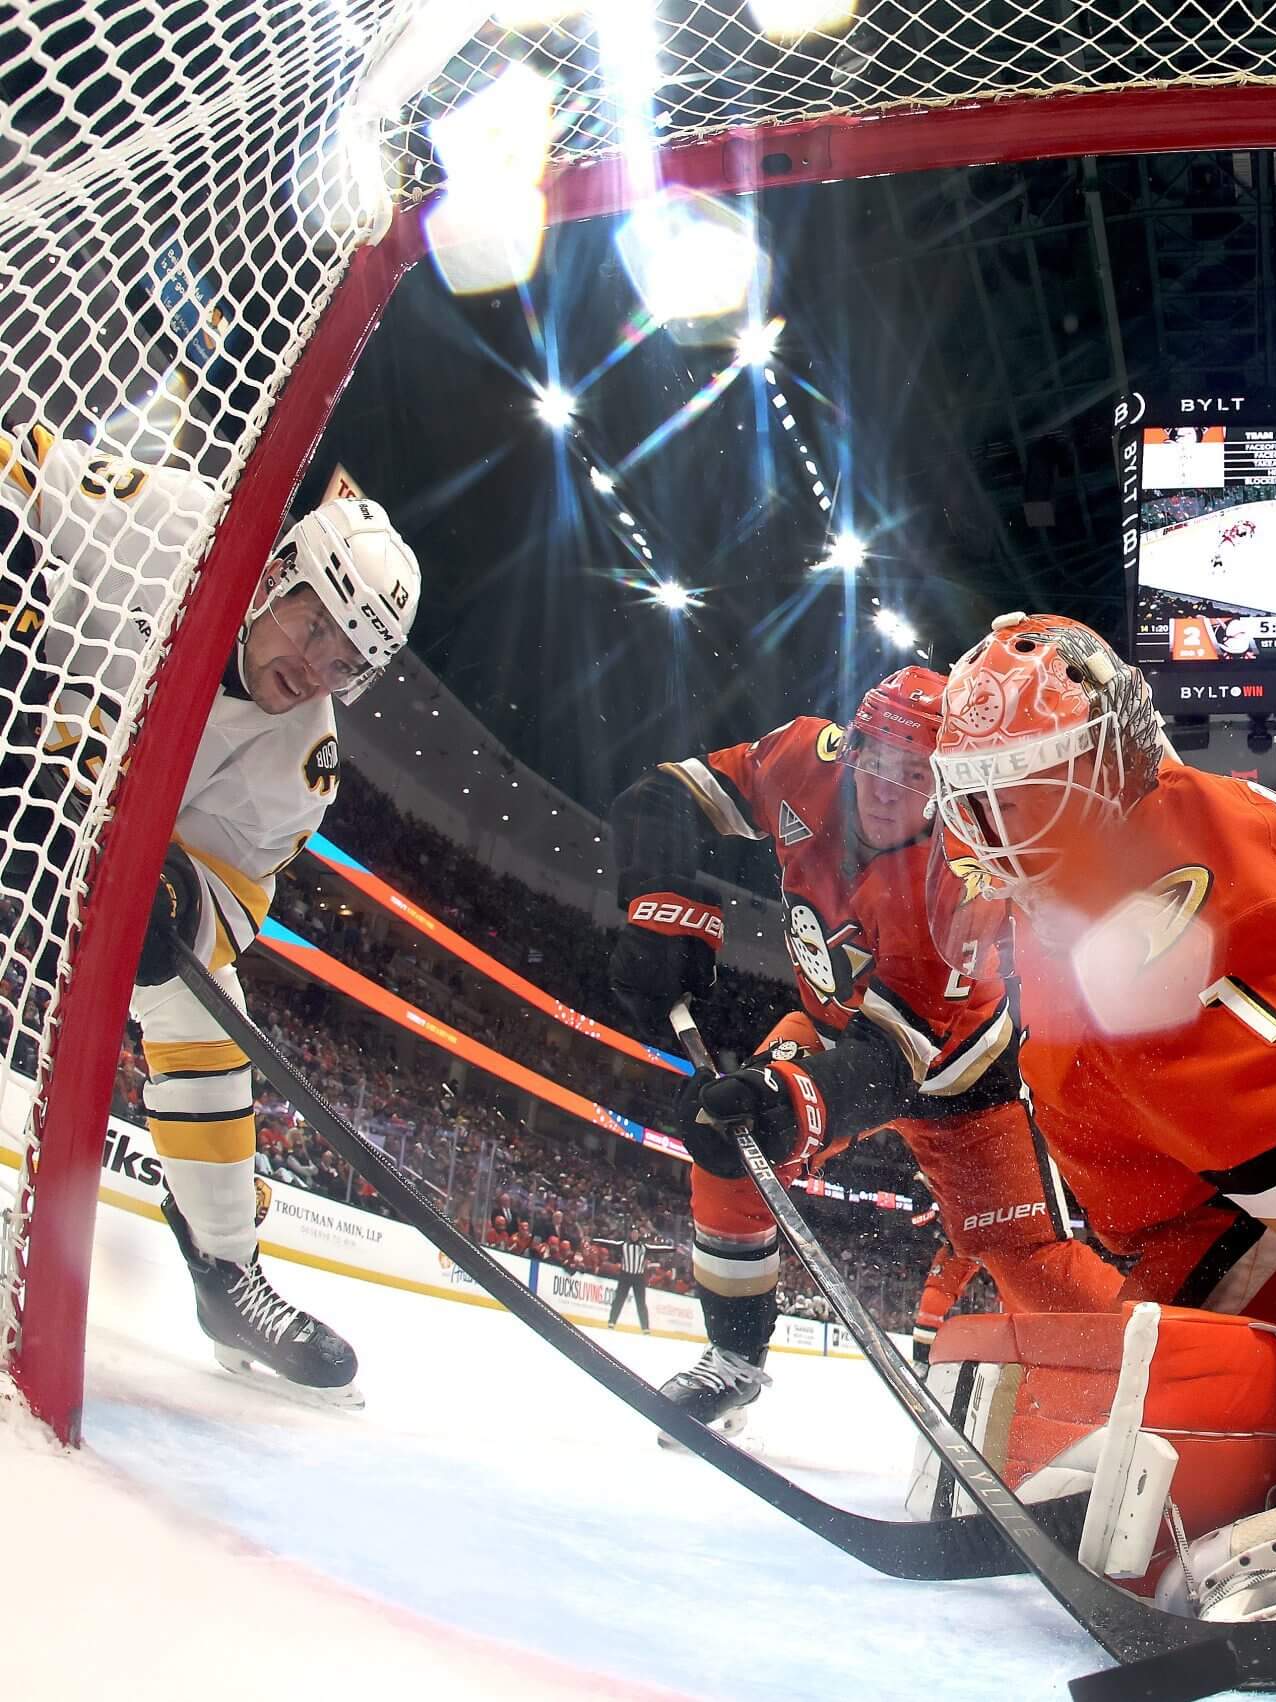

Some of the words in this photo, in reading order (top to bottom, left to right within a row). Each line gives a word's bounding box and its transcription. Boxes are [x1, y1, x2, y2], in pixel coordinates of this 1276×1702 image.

[1181, 398, 1245, 415] BYLT
[1123, 441, 1138, 503] BYLT
[390, 579, 410, 609] 13
[361, 602, 394, 642] CCM
[1183, 626, 1201, 647] 2
[909, 688, 924, 702] 2
[883, 711, 921, 729] BAUER
[274, 1199, 334, 1229] TROUTMAN
[336, 1220, 365, 1239] AMIN,
[366, 1228, 383, 1243] LLP
[963, 1202, 1046, 1231] BAUER
[553, 1275, 616, 1306] DUCKSLIVING.CO
